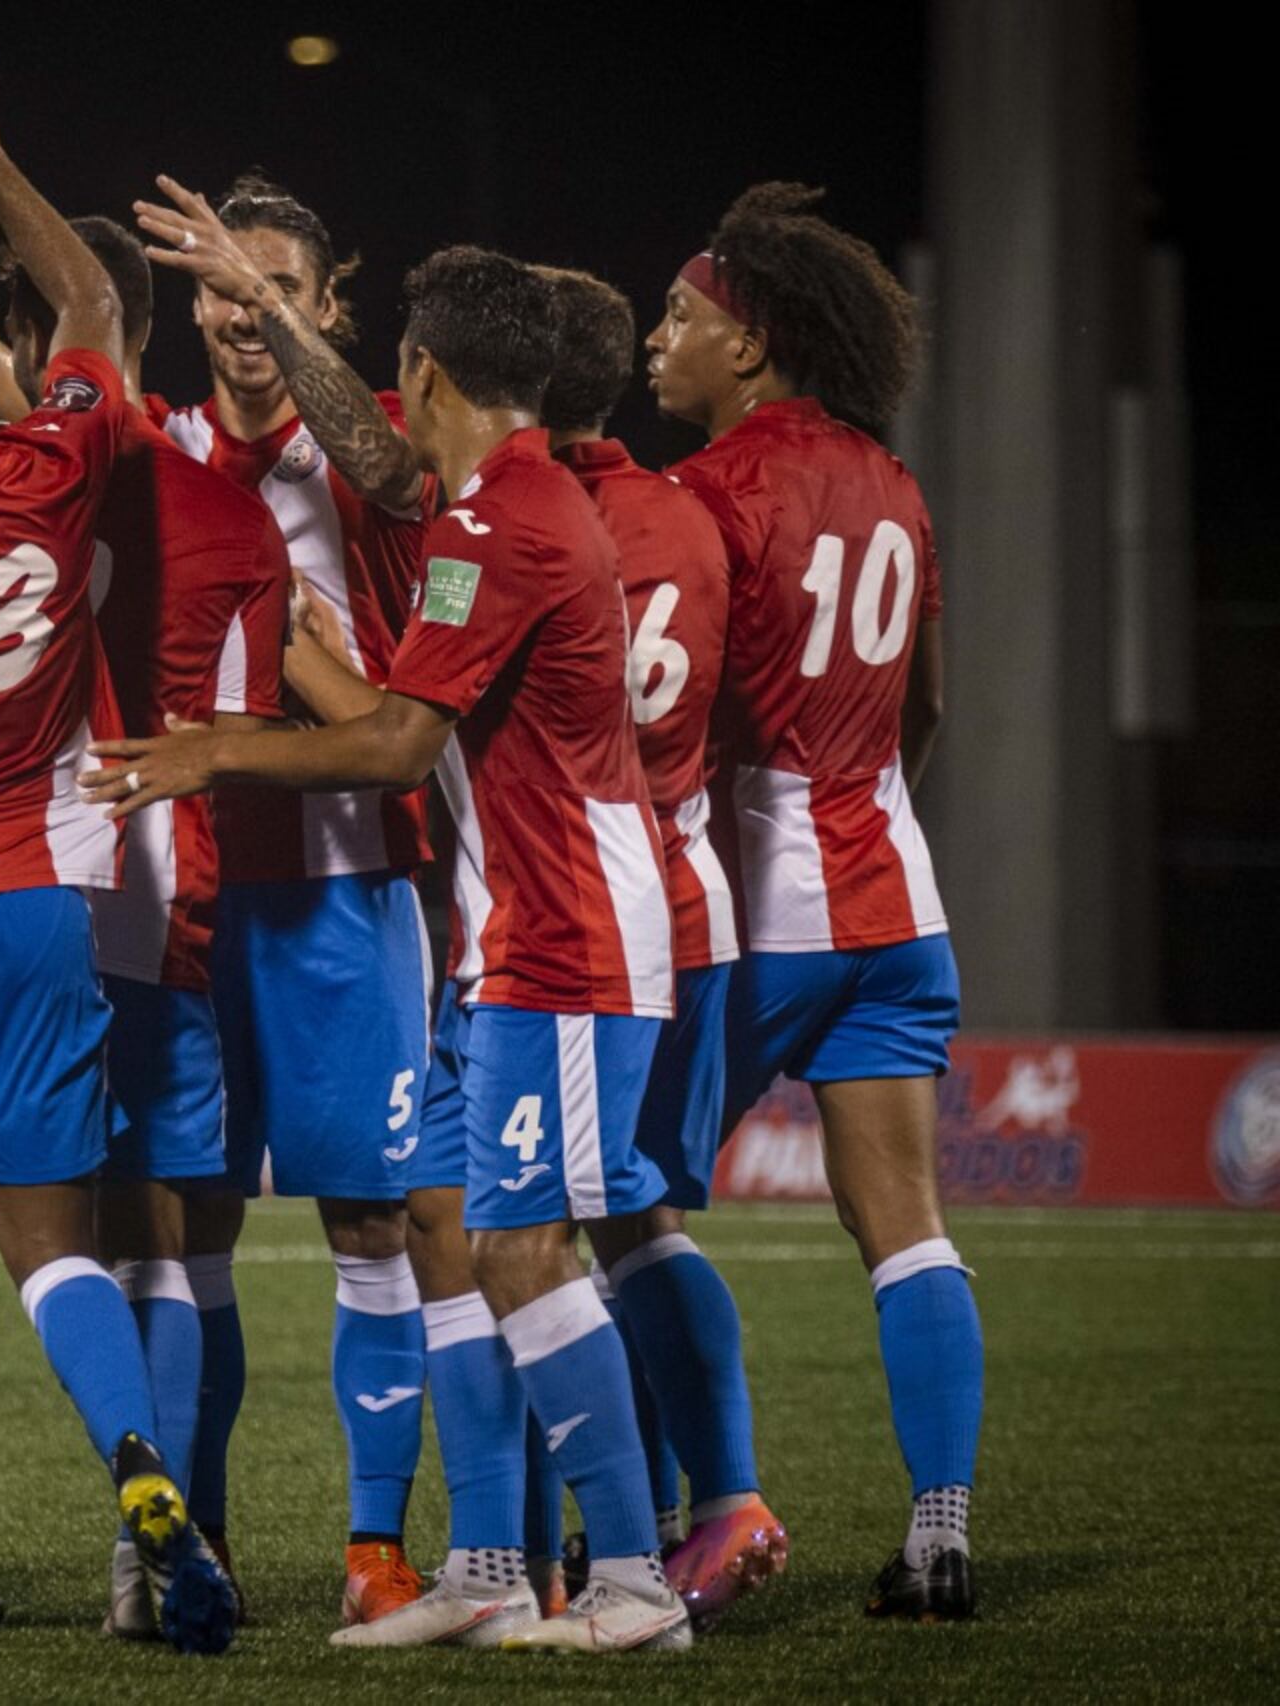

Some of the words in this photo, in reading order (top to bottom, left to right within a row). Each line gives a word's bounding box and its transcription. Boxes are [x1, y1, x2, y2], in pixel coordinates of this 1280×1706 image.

[800, 519, 917, 679] 10
[629, 582, 691, 725] 6
[387, 1068, 416, 1132] 5
[500, 1095, 545, 1162] 4
